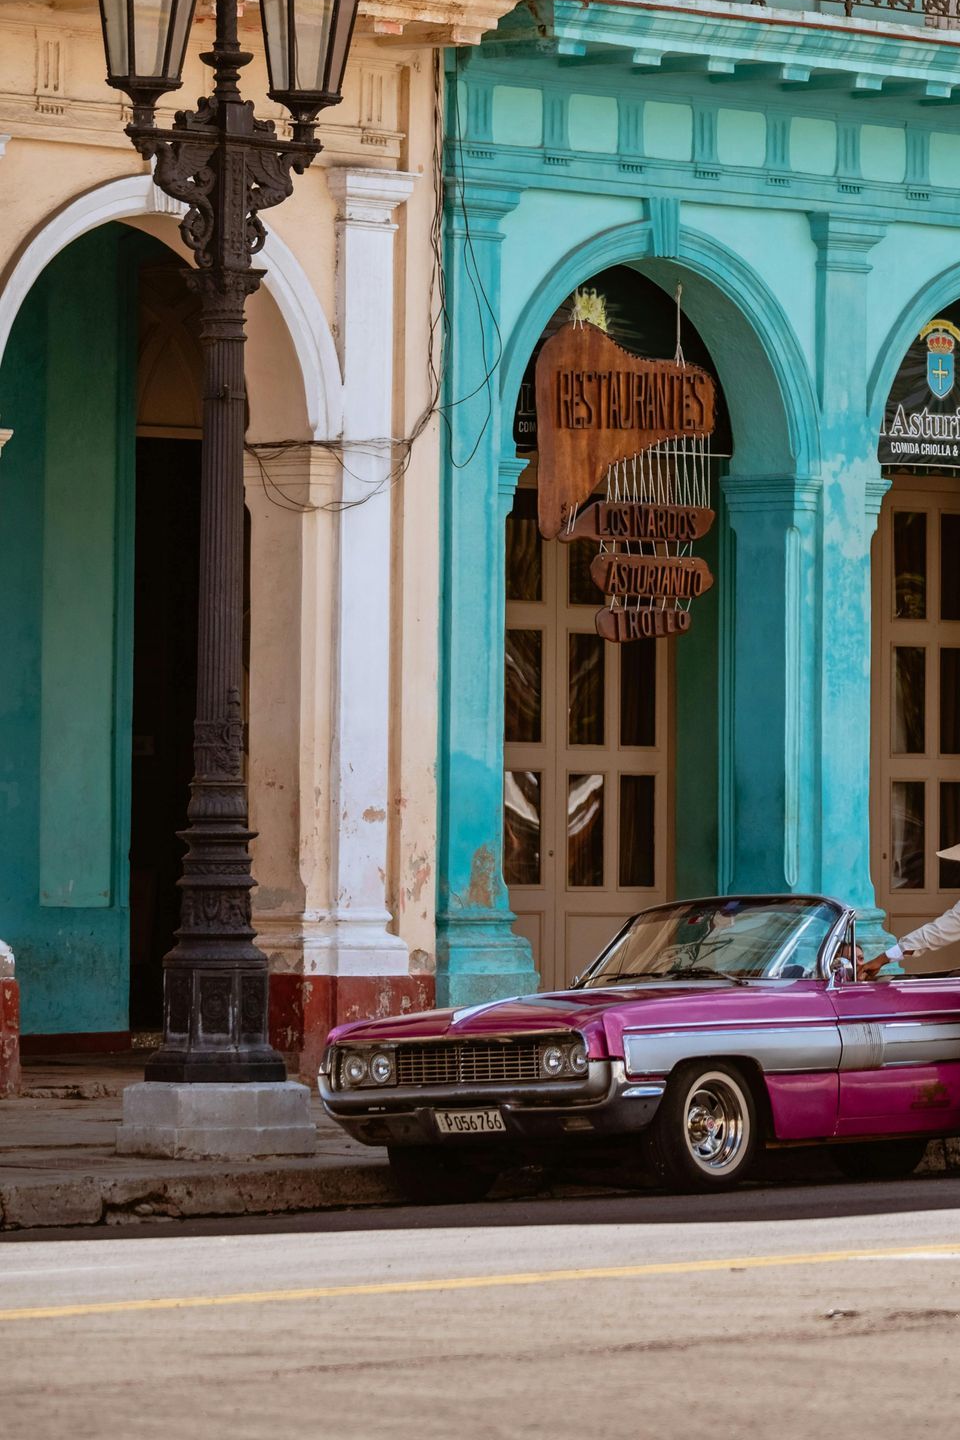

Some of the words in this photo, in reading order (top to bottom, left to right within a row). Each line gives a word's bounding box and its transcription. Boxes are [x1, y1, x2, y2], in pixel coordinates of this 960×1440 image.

[557, 370, 709, 430] RESTAURANTES
[890, 442, 919, 454] COMIDA
[921, 443, 951, 456] CRIOLLA
[952, 446, 958, 456] &
[595, 503, 630, 536] LOS
[633, 505, 698, 540] NARDOS
[606, 561, 703, 597] ASTURIANITO
[444, 1111, 502, 1131] P056766
